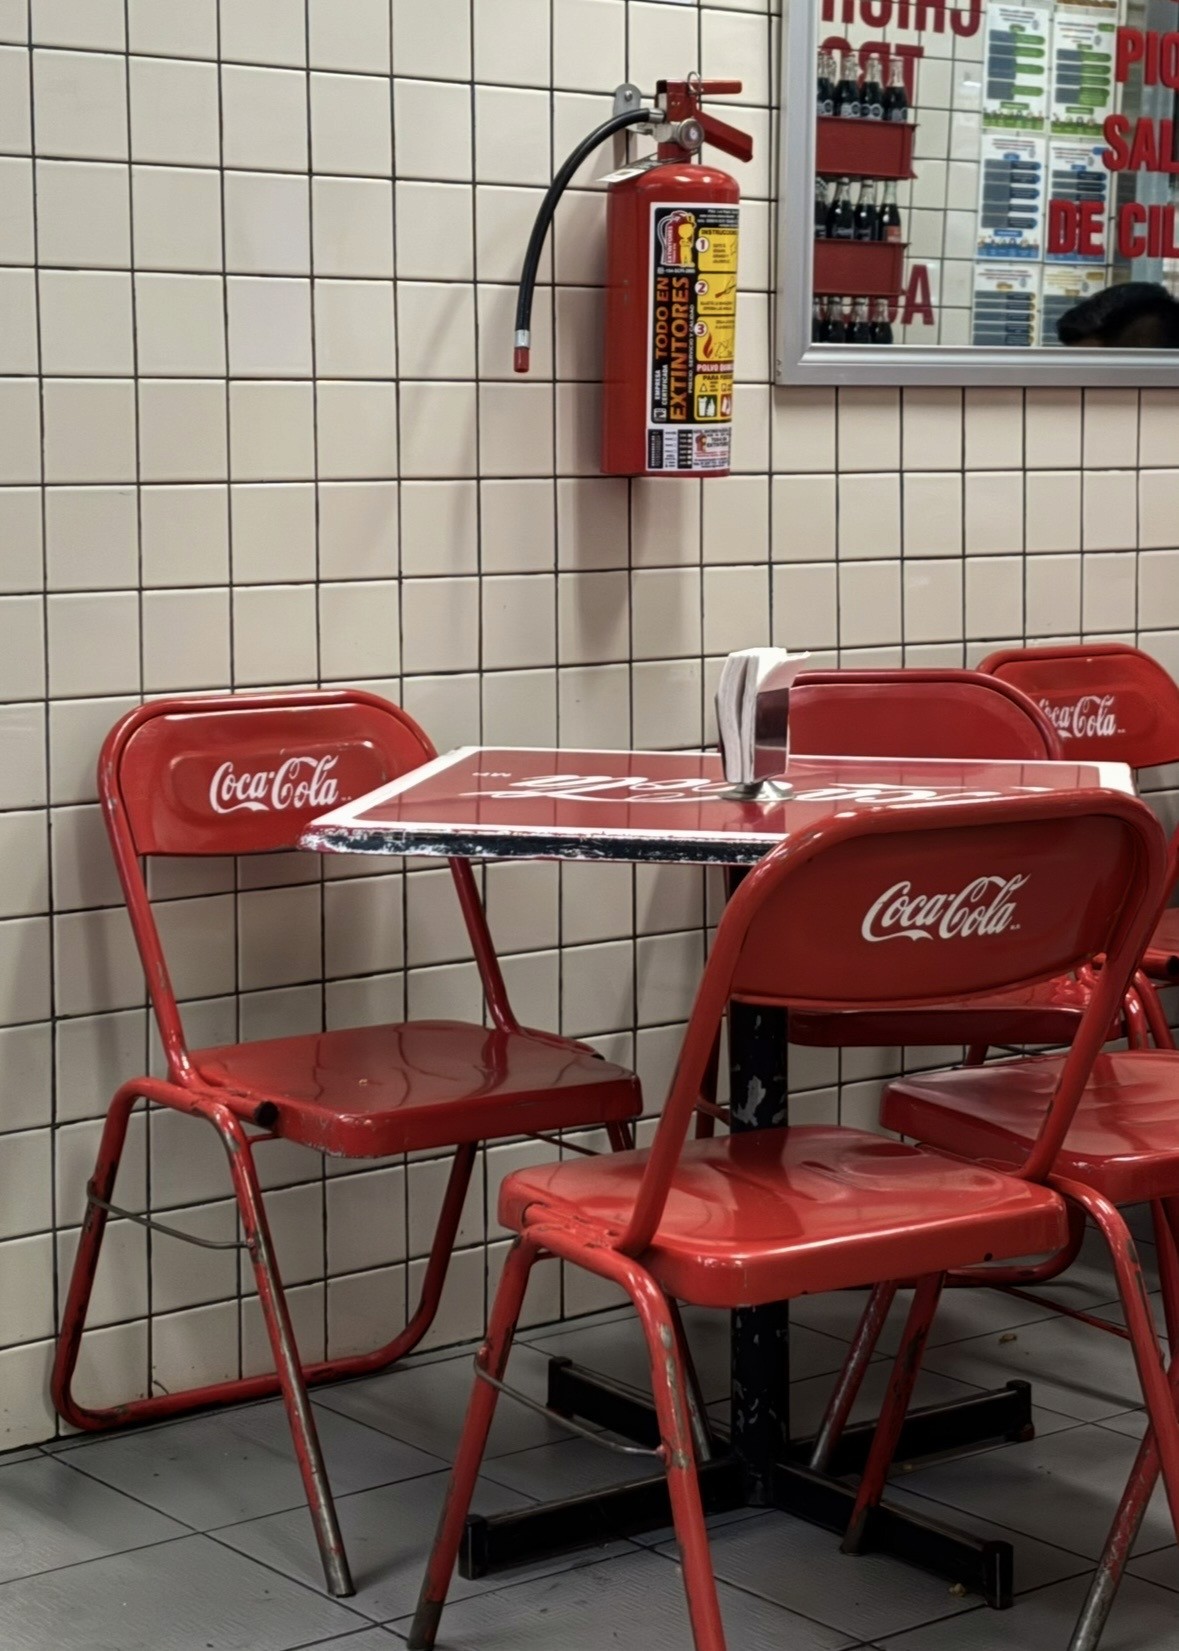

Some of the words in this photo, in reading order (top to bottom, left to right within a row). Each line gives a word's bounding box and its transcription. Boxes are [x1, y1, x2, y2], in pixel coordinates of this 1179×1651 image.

[1102, 114, 1179, 173] SAL
[1047, 198, 1105, 256] DE
[1118, 202, 1179, 259] CIL
[700, 239, 705, 250] 1
[657, 276, 669, 302] EN
[697, 282, 706, 293] 2
[656, 306, 669, 359] TODO
[697, 323, 705, 334] 3
[670, 276, 689, 420] EXTINTORES
[696, 363, 718, 372] POLVO
